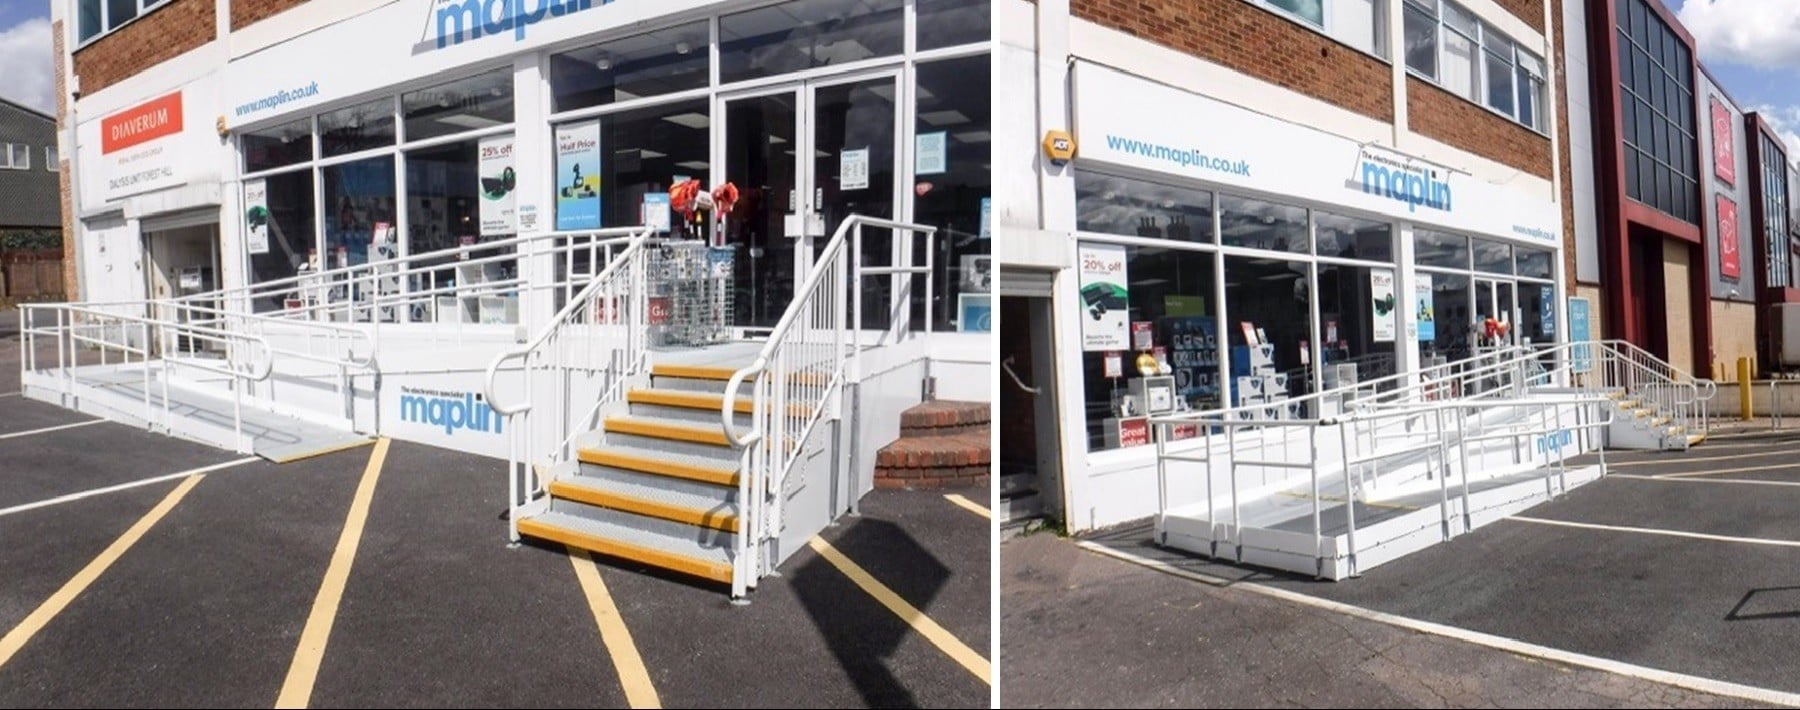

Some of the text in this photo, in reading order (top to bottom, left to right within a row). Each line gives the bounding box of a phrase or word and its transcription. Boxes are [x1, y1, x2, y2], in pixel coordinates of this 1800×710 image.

[437, 0, 615, 49] map
[236, 81, 319, 116] www.maplin.co.uk
[111, 107, 168, 141] DIAVERUM
[1106, 134, 1251, 177] www.maplin.co.uk
[1362, 161, 1451, 213] maplin
[1084, 260, 1121, 271] 20% off
[401, 391, 502, 435] maplin
